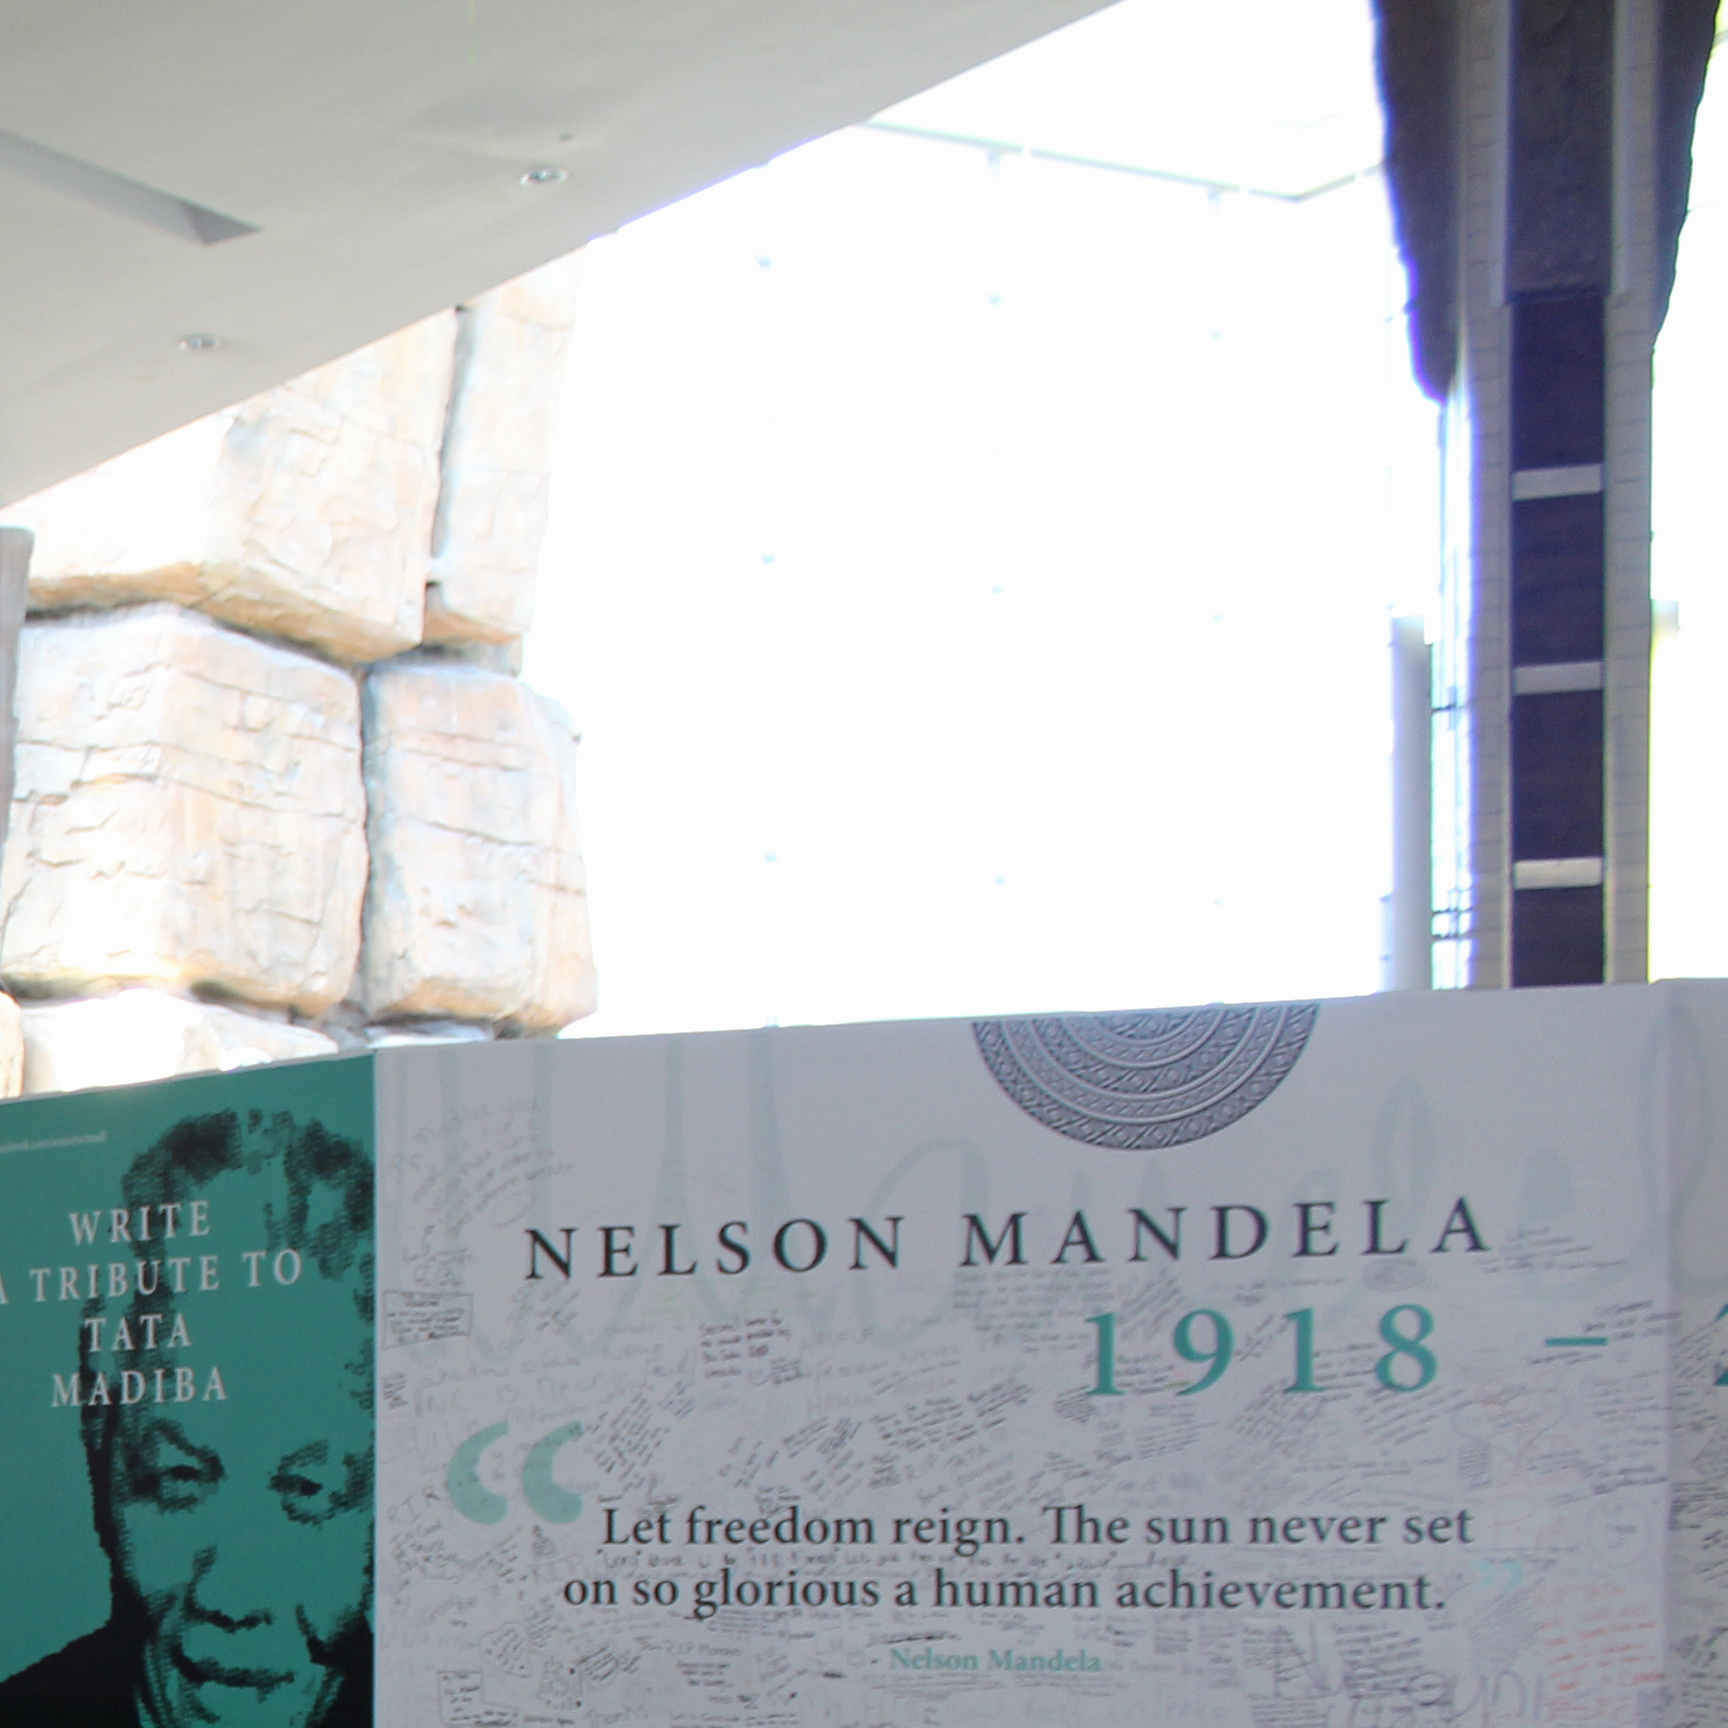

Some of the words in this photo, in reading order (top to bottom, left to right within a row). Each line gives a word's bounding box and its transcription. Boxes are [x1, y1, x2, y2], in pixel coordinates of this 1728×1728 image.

[69, 1200, 212, 1246] WRITE
[523, 1216, 905, 1281] NELSON
[961, 1196, 1491, 1267] MANDELA
[30, 1255, 220, 1303] TRIBUTE
[243, 1248, 302, 1288] TO
[84, 1313, 192, 1353] TATA
[1085, 1302, 1439, 1398] 1918
[50, 1366, 228, 1408] MADIBA
[603, 1507, 671, 1546] Let
[686, 1505, 875, 1546] freedom
[892, 1508, 1024, 1559] reign.
[1043, 1504, 1131, 1545] The
[1145, 1511, 1231, 1546] sun
[1249, 1510, 1387, 1546] never
[1403, 1505, 1473, 1545] set
[563, 1578, 616, 1607] on
[632, 1578, 679, 1607] so
[693, 1567, 880, 1621] glorious
[895, 1578, 917, 1608] a
[933, 1567, 1098, 1609] human
[1117, 1567, 1446, 1611] achievement.
[890, 1647, 978, 1672] Nelson
[986, 1647, 1102, 1673] Mandela
